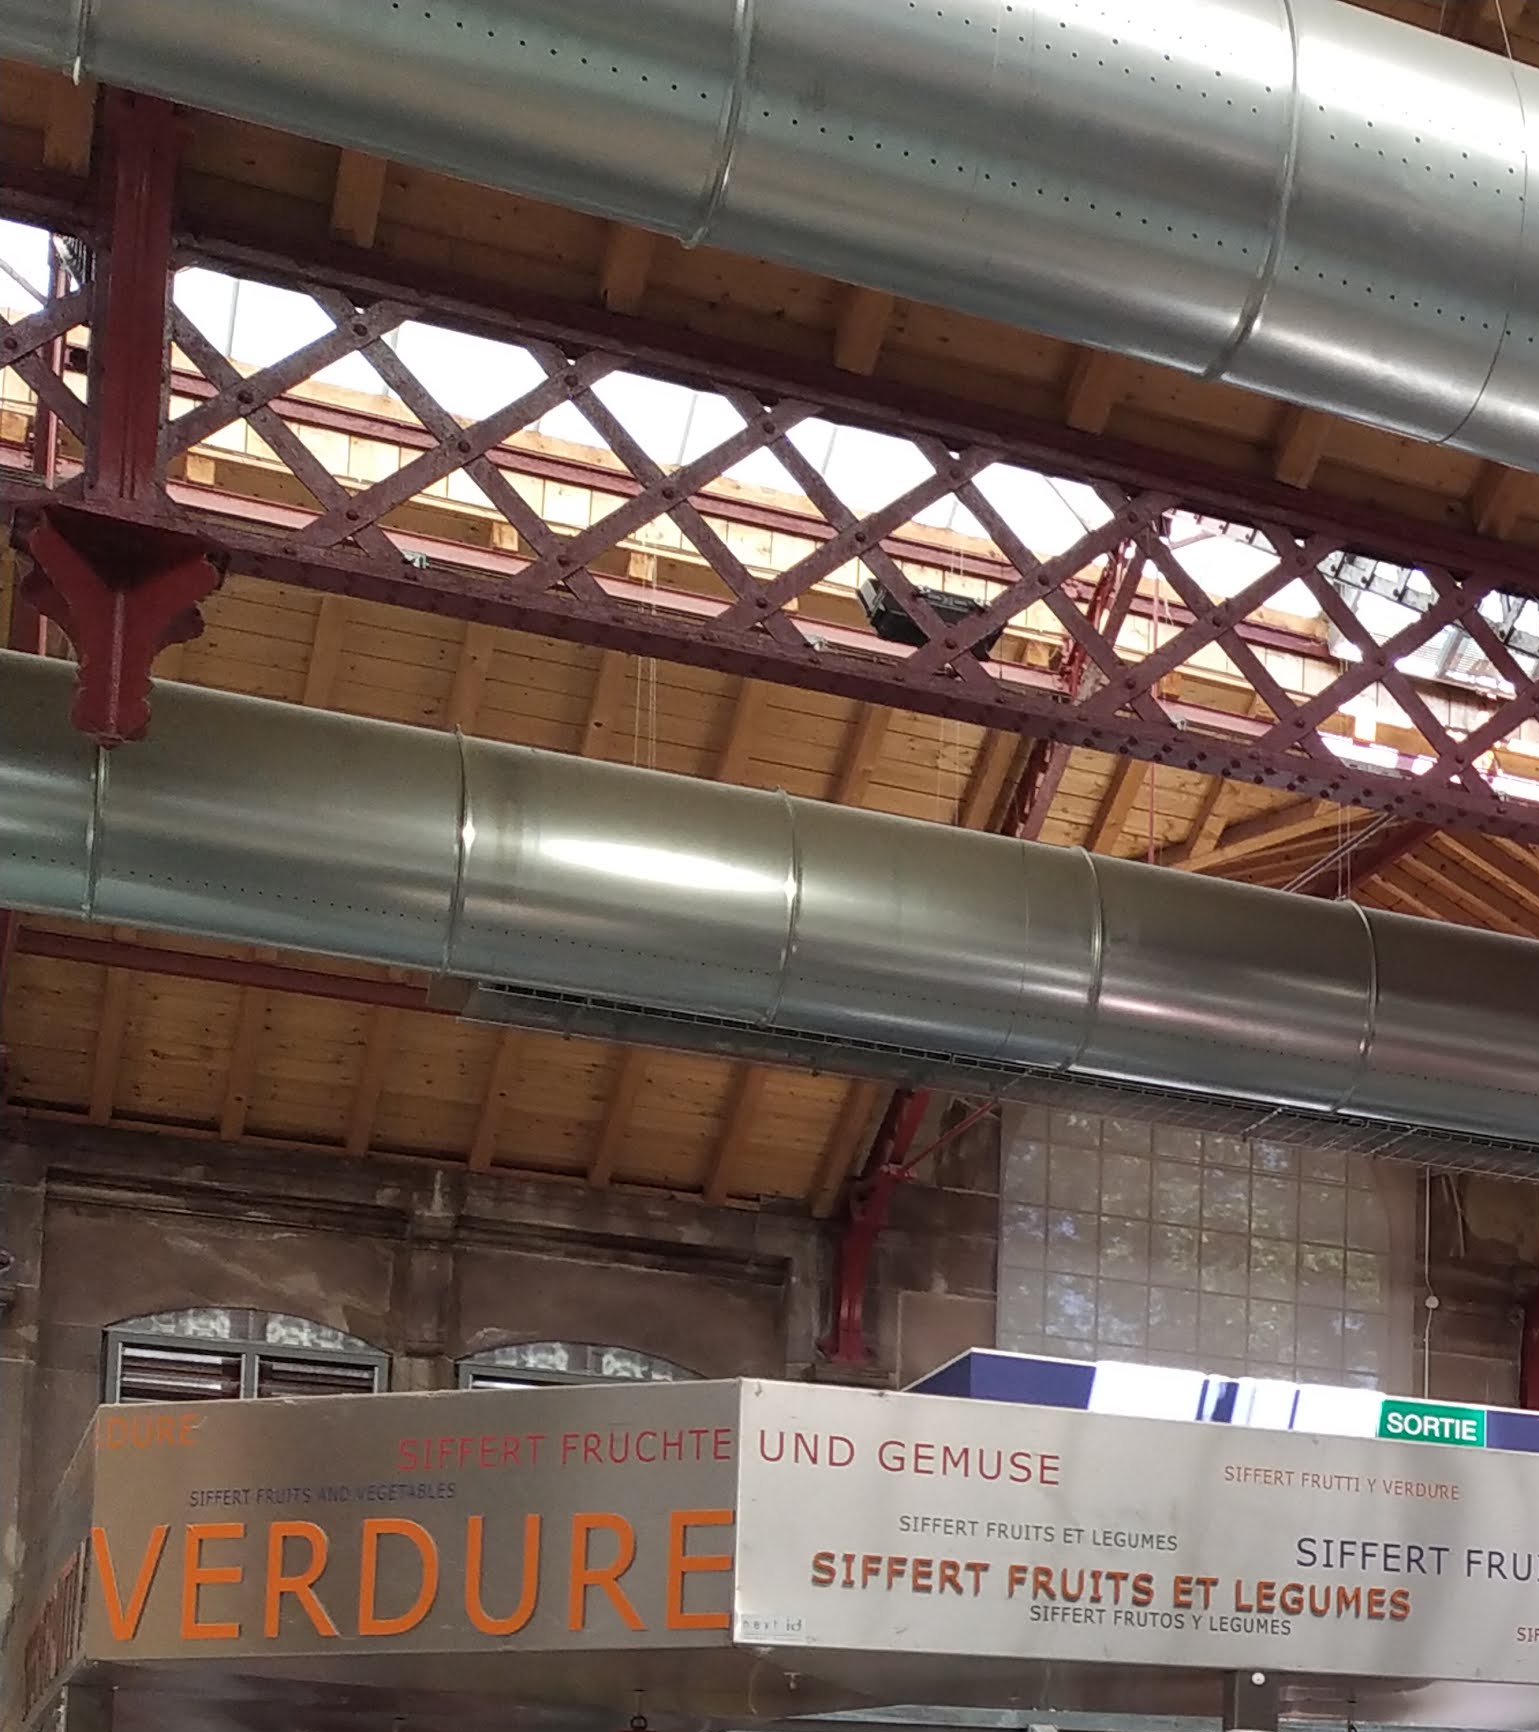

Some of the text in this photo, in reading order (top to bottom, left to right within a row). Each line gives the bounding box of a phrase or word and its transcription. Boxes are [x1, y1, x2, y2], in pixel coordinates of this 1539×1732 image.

[1386, 1411, 1478, 1442] SORTIE
[399, 1429, 1059, 1485] SIFFERT FRUCHTE UND GEMUSE
[190, 1483, 456, 1507] SIFFERT FRUITS AND VEGETABLES
[1225, 1466, 1458, 1500] SIFFERT FRUTTI Y VERDURE
[900, 1516, 1177, 1551] SIFFERT FRUITS ET LEGUMES
[1297, 1538, 1449, 1574] SIFFERT
[92, 1509, 734, 1642] VERDURE
[812, 1552, 1409, 1621] SIFFERT FRUITS ET LEGUMES
[1030, 1605, 1290, 1635] SIFFERT FRUTOS Y LEGUMES
